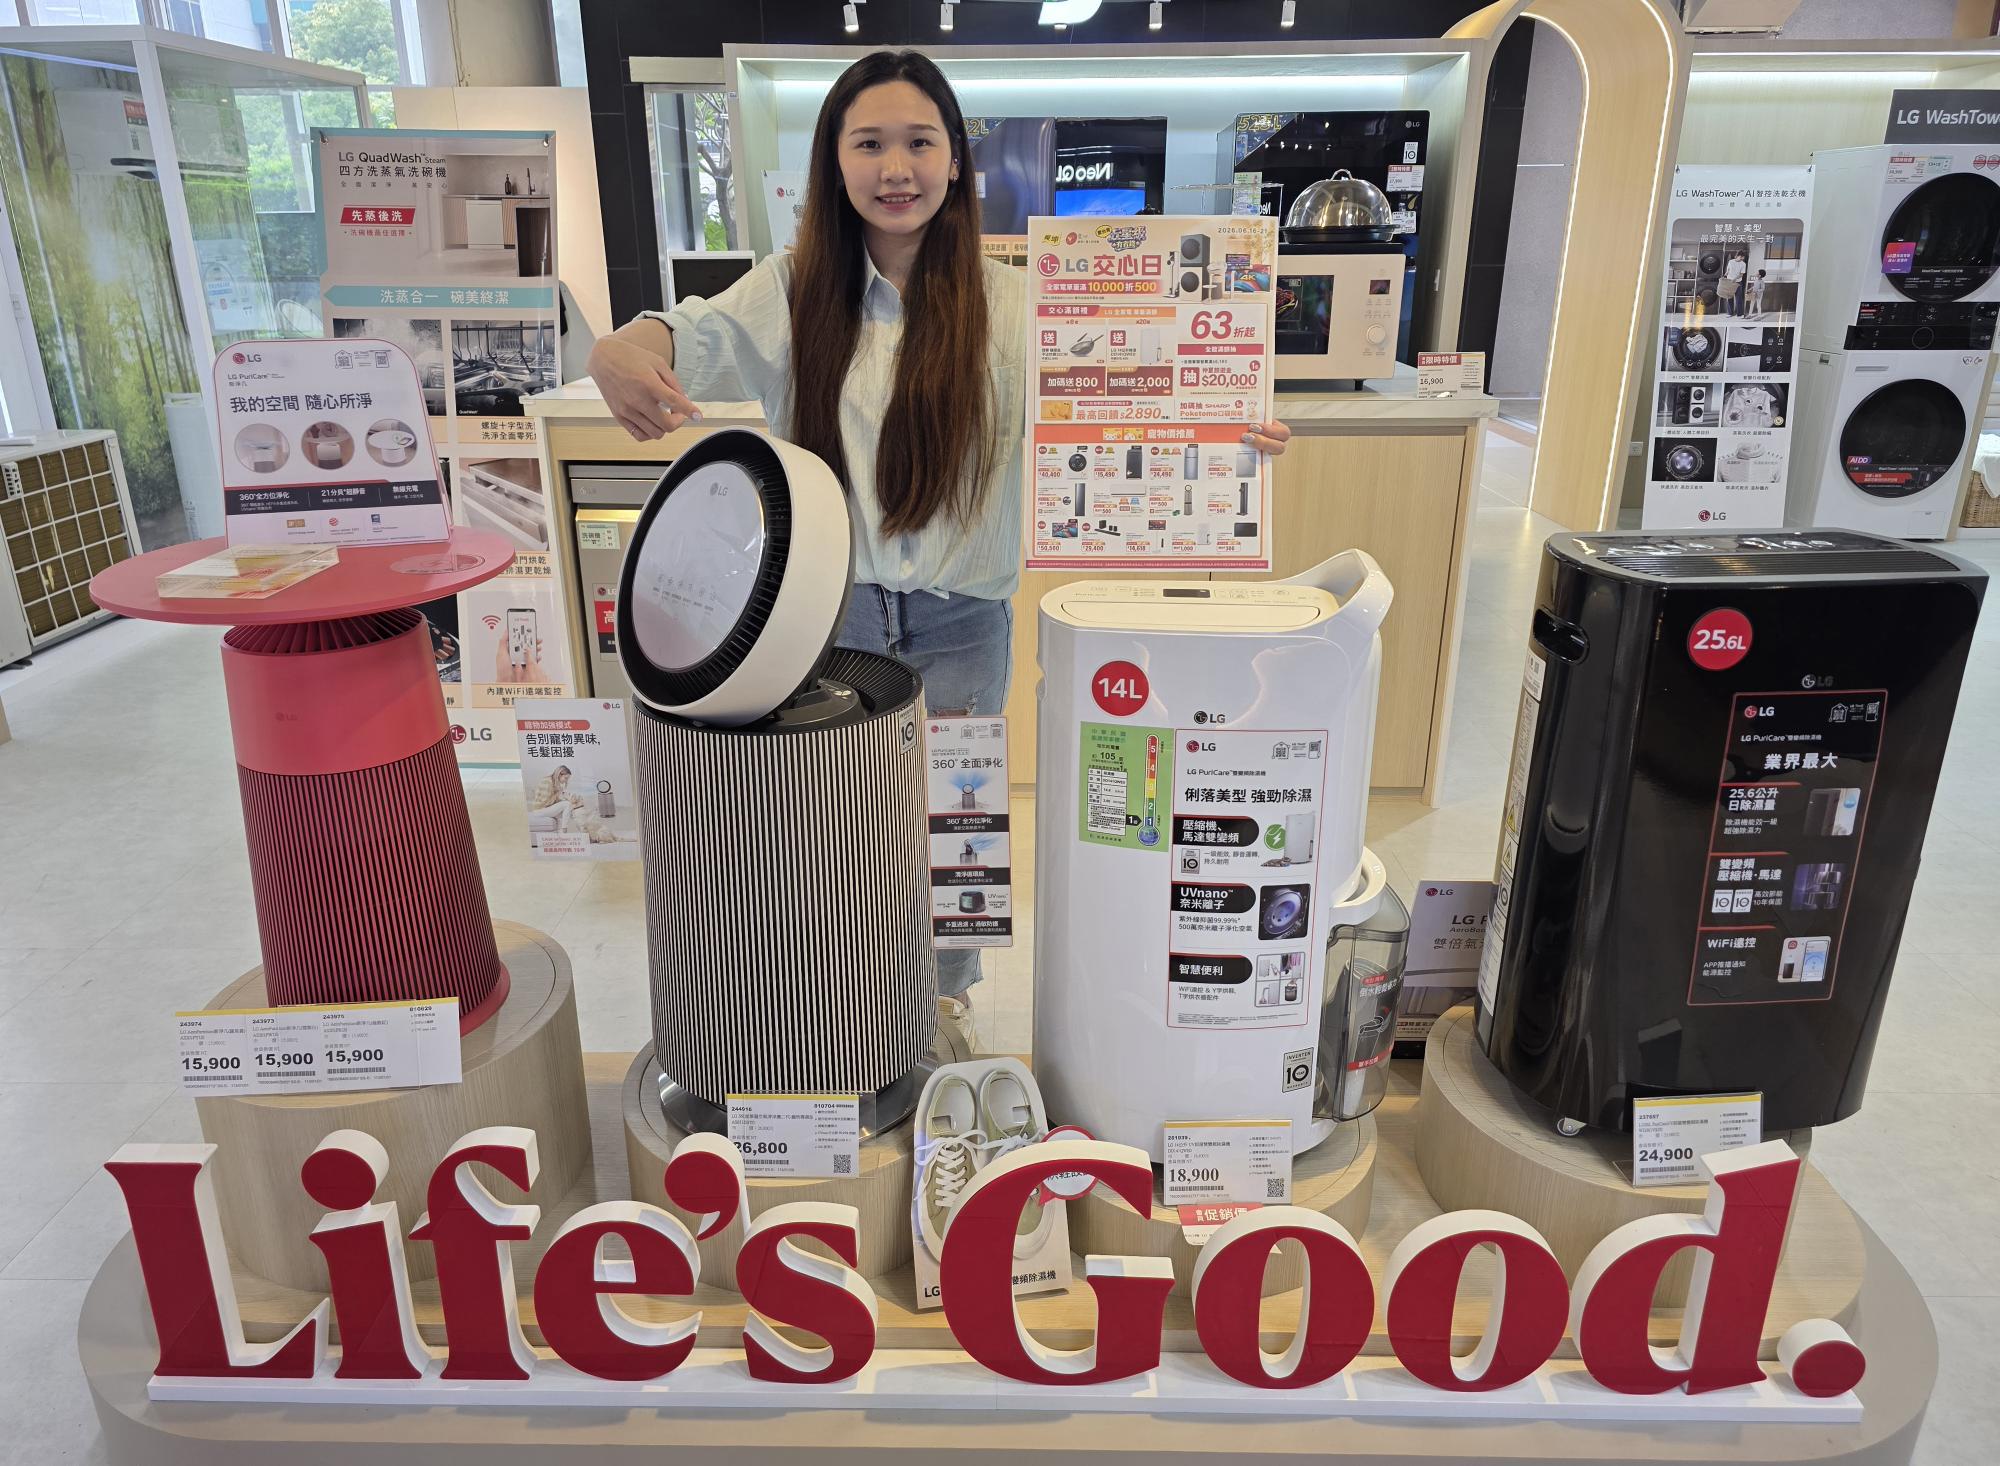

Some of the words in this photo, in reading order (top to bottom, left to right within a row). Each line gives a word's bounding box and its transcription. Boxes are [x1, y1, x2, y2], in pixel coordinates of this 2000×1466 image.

[1238, 116, 1281, 130] 525L
[1897, 110, 1920, 124] LG
[339, 152, 354, 162] LG
[339, 166, 447, 178] 四方洗蒸氣洗碗機
[785, 189, 795, 197] LG
[351, 210, 403, 222] 先蒸後洗
[1715, 224, 1732, 233] 智慧
[1744, 224, 1762, 233] 美型
[1700, 234, 1774, 243] 最完美的天生一對
[1066, 259, 1088, 272] LG
[1094, 254, 1161, 276] 交心日
[380, 289, 438, 302] 洗蒸合一
[450, 290, 509, 304] 碗美終潔
[1191, 311, 1232, 339] 63
[1234, 327, 1255, 338] 折起
[1043, 332, 1055, 344] 送
[1112, 332, 1124, 344] 送
[248, 354, 261, 362] LG
[1184, 370, 1196, 383] 抽
[1202, 374, 1257, 387] $20,000
[230, 395, 299, 413] 我的空間
[306, 392, 372, 410] 隨心所淨
[481, 422, 535, 430] 螺旋十字型洗
[481, 432, 536, 440] 洗淨全面零死
[718, 486, 728, 496] LG
[1713, 512, 1726, 520] LG
[1694, 630, 1746, 650] 25.6L
[1818, 676, 1834, 686] LG
[1098, 678, 1142, 699] 14L
[1759, 707, 1774, 716] LG
[1210, 714, 1225, 723] LG
[525, 721, 571, 729] 寵物加強模式
[471, 728, 492, 741] LG
[527, 747, 575, 758] 毛髮困擾
[1202, 743, 1216, 751] LG
[961, 758, 1003, 768] 全面淨化
[1764, 752, 1838, 769] 業界最大
[1185, 788, 1246, 803] 俐落美型
[1251, 788, 1312, 803] 強勁除濕
[1729, 788, 1779, 798] 25.6公升
[1728, 800, 1775, 811] 日除濕量
[1720, 858, 1755, 869] 雙變頻
[1180, 900, 1225, 910] 奈米離子
[1452, 915, 1477, 925] LG
[1708, 937, 1756, 948] WiFi遠控
[1179, 964, 1222, 976] 智慧便利
[255, 1053, 314, 1068] 15,900
[325, 1049, 384, 1063] 15,900
[182, 1057, 241, 1072] 15,900
[1286, 1064, 1309, 1085] 10
[1639, 1148, 1693, 1162] 24,900
[1169, 1168, 1219, 1184] 18,900
[939, 1142, 1867, 1399] Good.
[924, 1286, 940, 1298] LG
